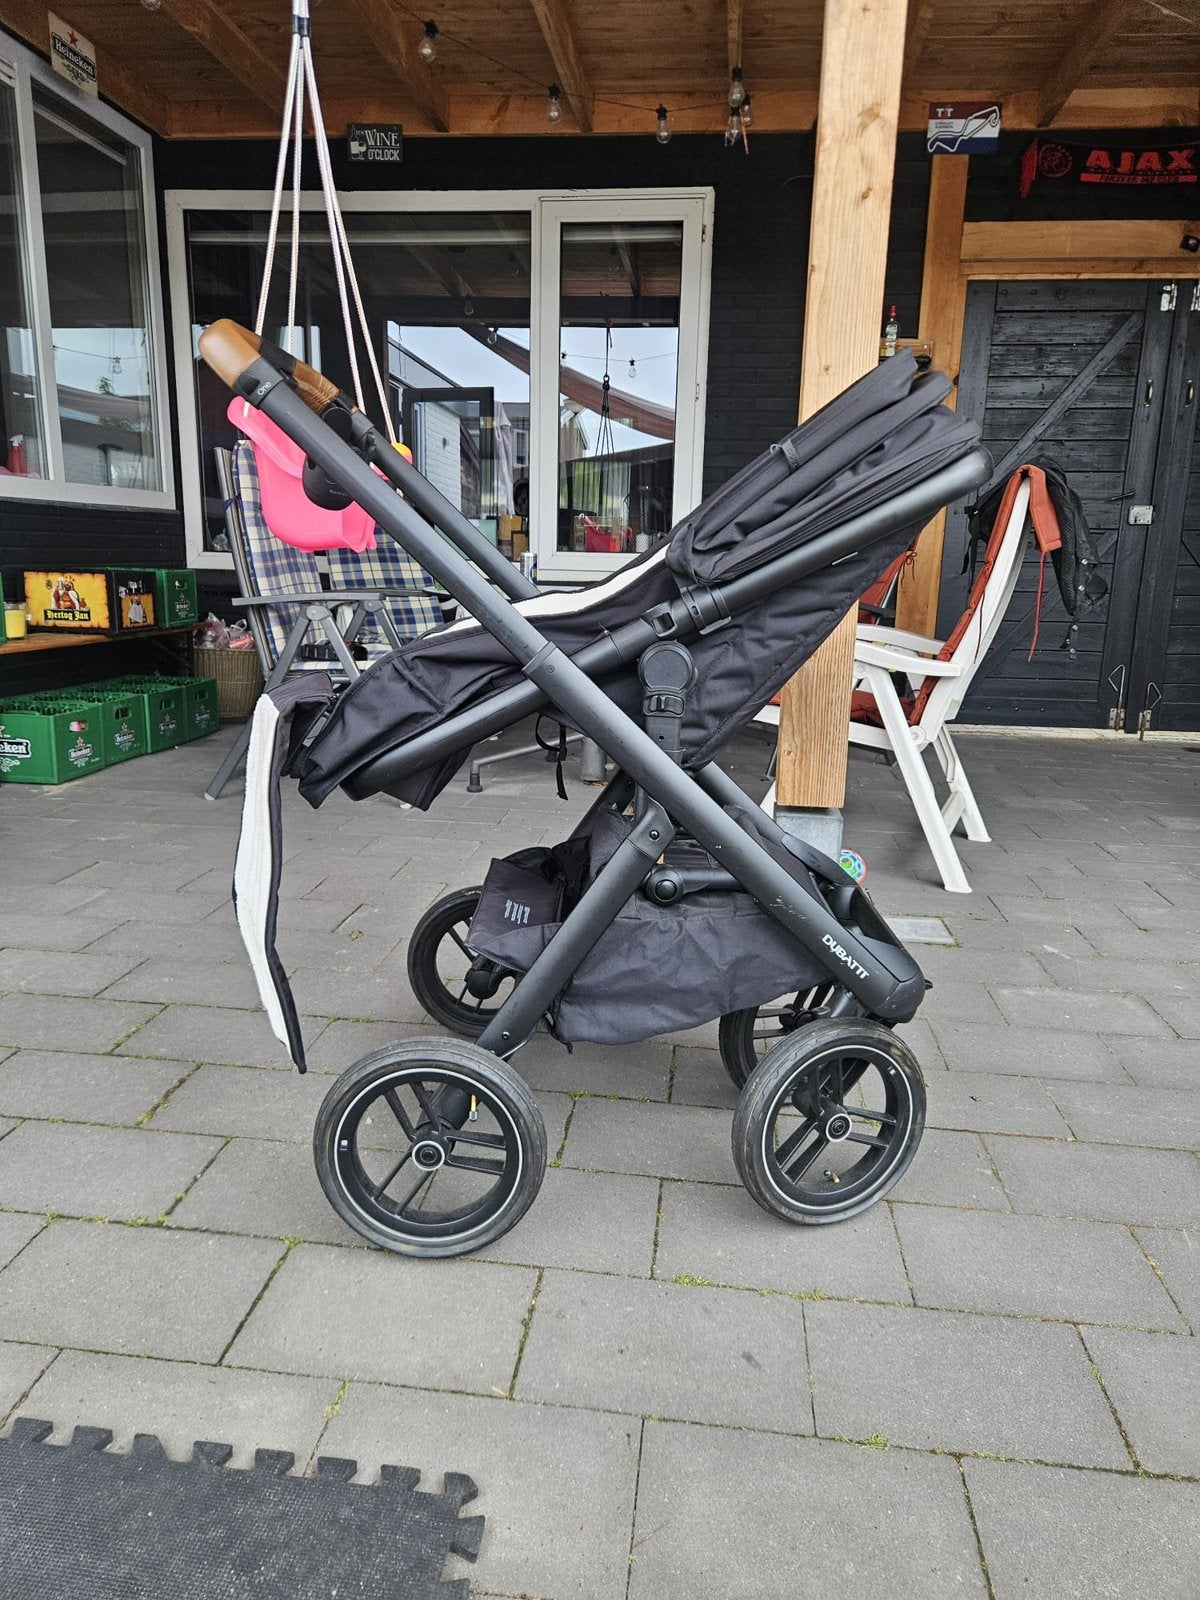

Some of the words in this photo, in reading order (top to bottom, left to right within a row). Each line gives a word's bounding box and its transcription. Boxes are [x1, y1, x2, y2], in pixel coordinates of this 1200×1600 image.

[55, 38, 93, 75] Heineken
[936, 108, 954, 117] TT
[365, 129, 400, 146] WINE
[368, 149, 400, 161] O'CLOCK
[1086, 150, 1195, 174] AJAX
[46, 610, 73, 620] Hertog
[74, 611, 89, 621] Jan
